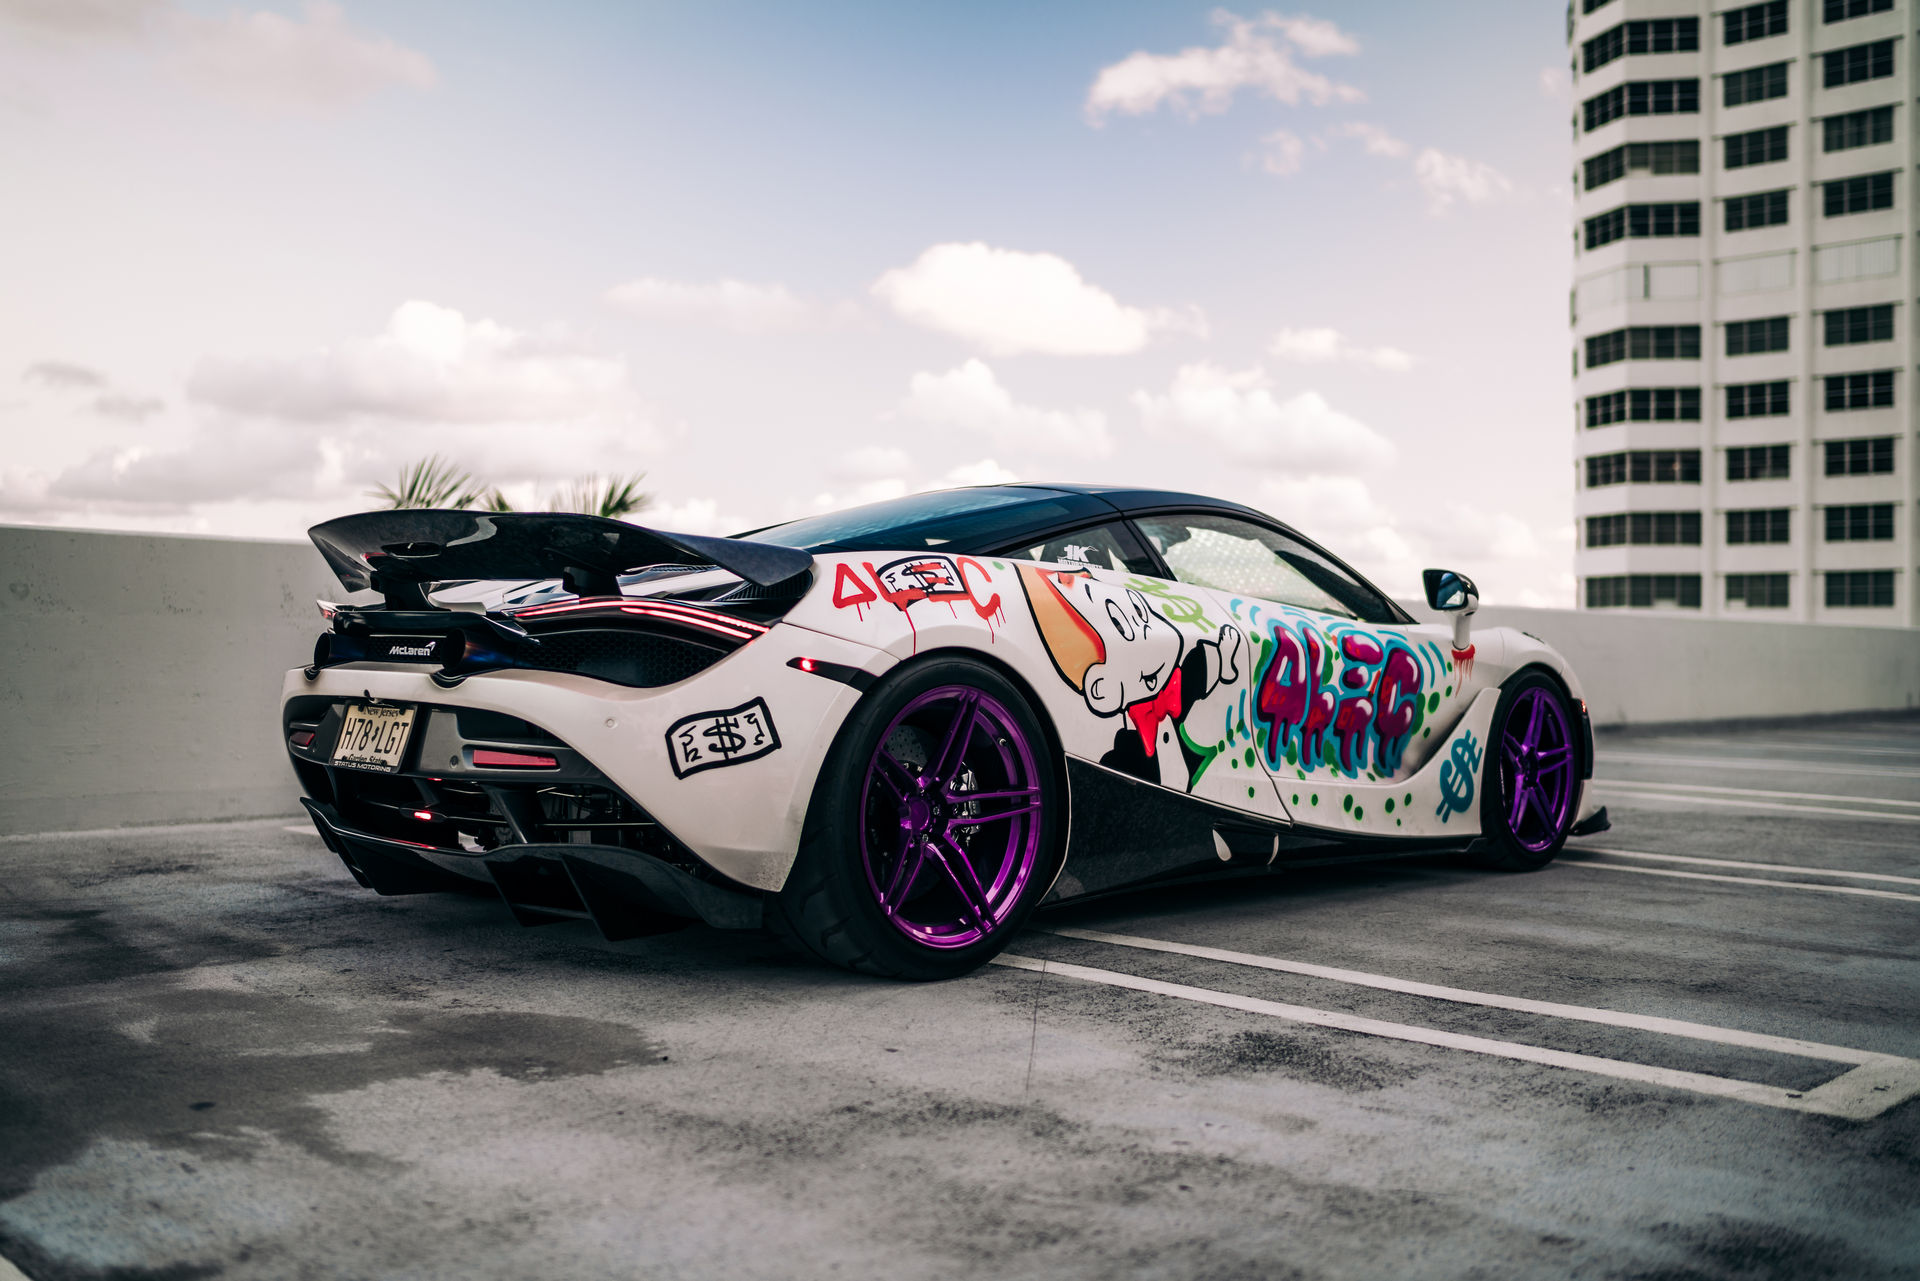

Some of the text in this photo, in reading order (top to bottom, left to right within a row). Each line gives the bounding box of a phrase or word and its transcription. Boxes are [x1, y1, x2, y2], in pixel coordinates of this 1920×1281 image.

[389, 645, 431, 656] McLaren
[1253, 619, 1423, 779] ALEC
[363, 706, 400, 719] New Jersey
[334, 760, 392, 773] STATUS MOTORING
